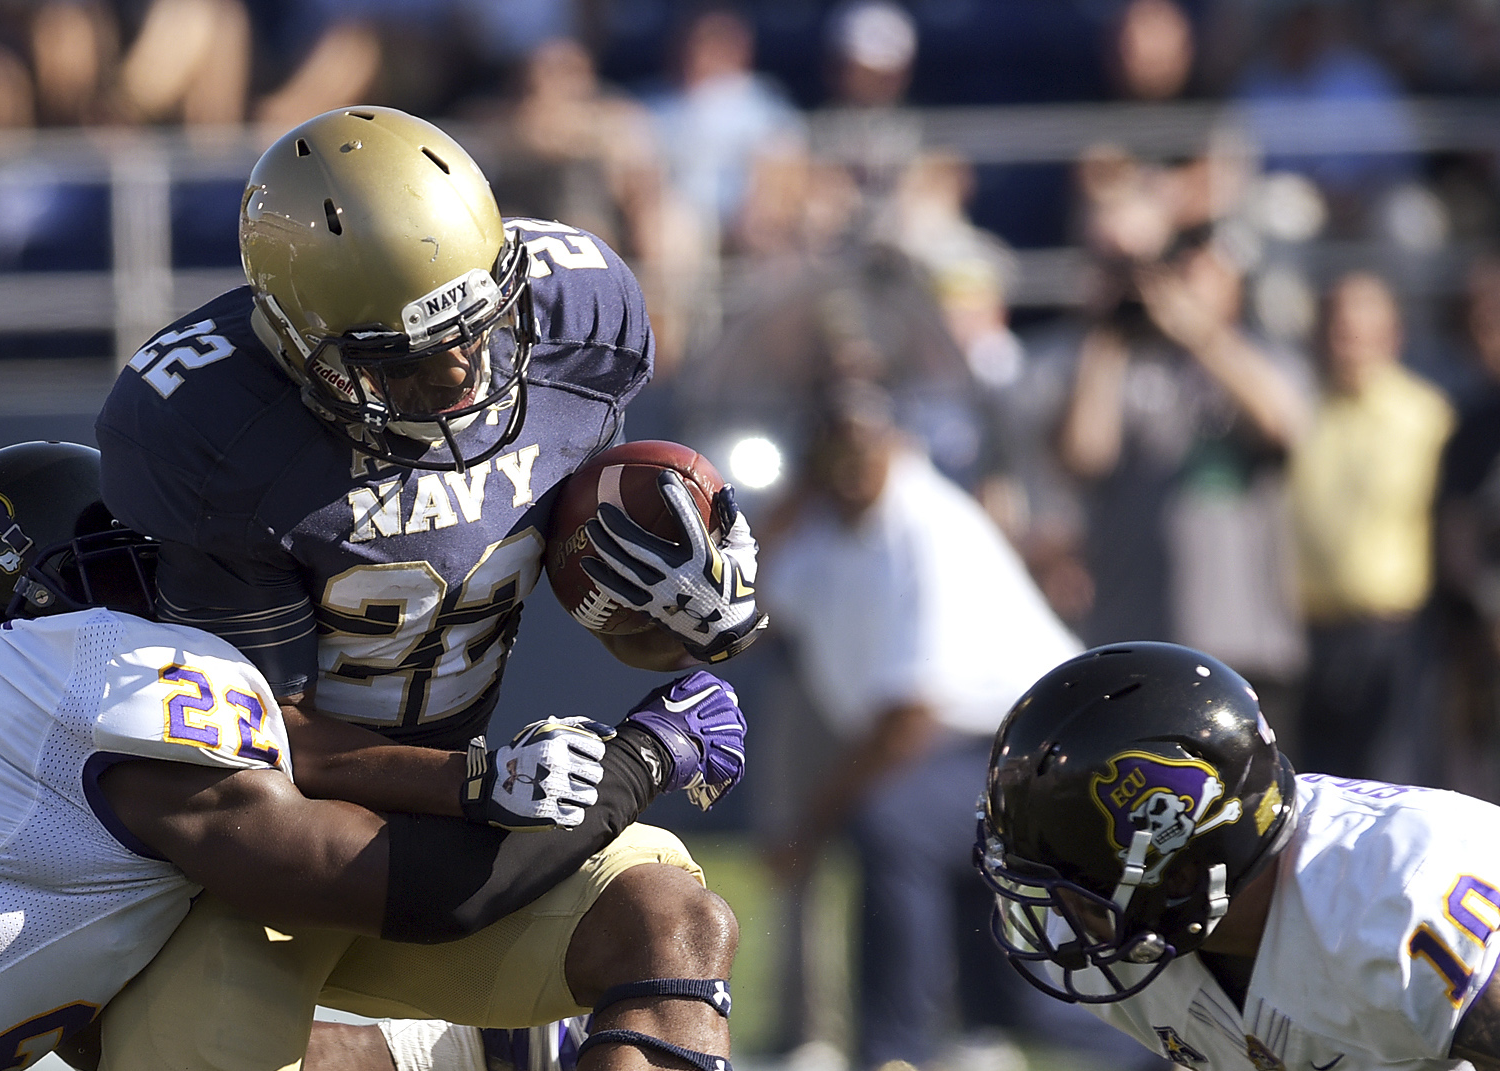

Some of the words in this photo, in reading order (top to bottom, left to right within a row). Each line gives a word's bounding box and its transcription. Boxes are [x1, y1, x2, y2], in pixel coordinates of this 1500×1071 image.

[426, 281, 468, 316] NAVY
[126, 318, 237, 399] 22
[348, 444, 539, 542] NAVY
[314, 526, 546, 727] 22
[158, 662, 282, 767] 22
[1110, 767, 1147, 809] ECU
[1406, 872, 1500, 1010] 10
